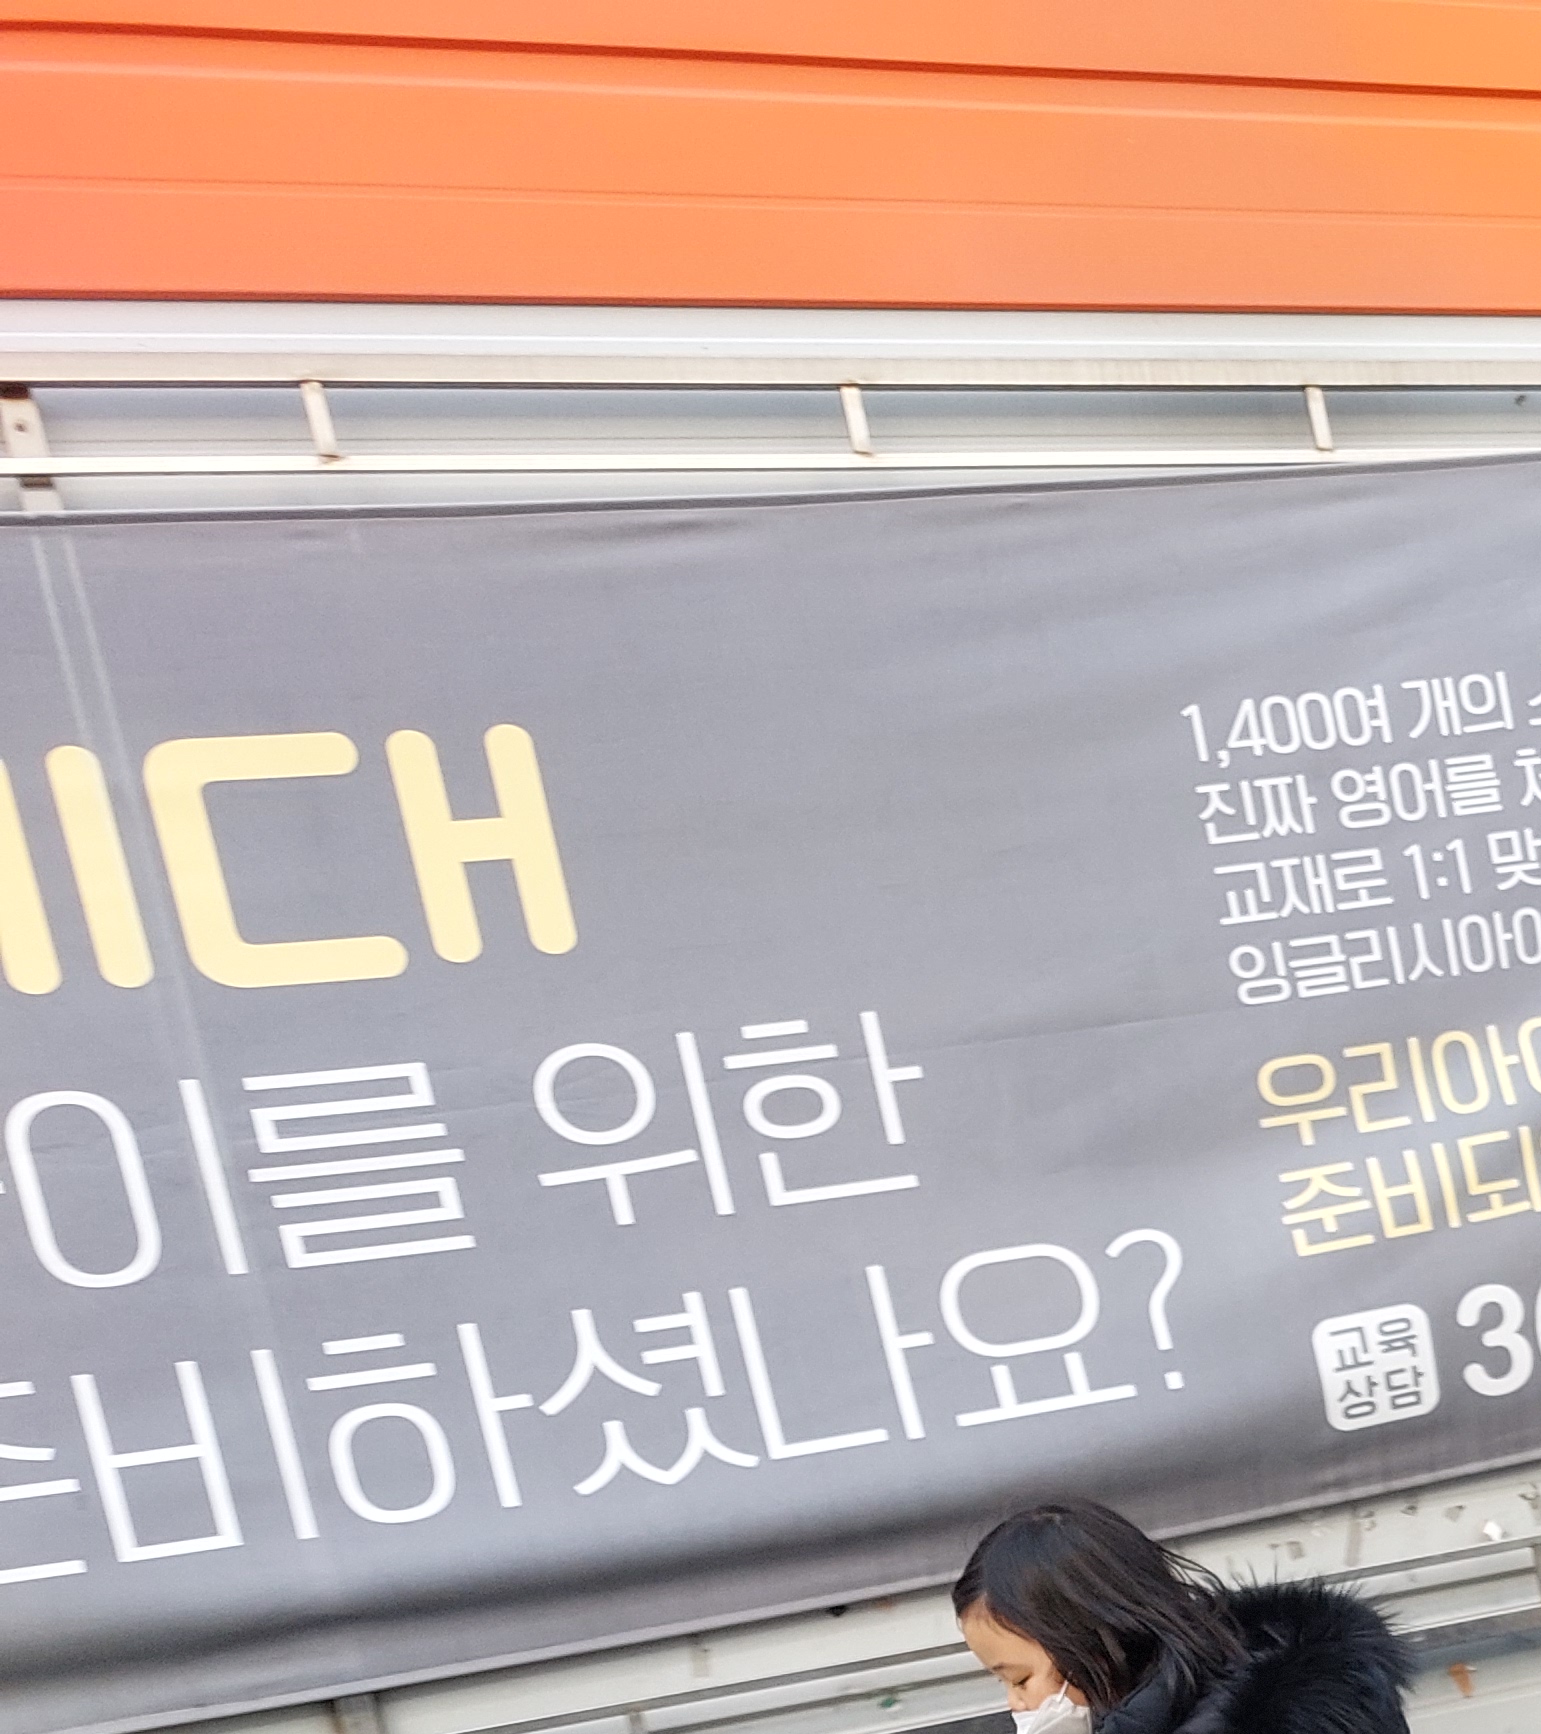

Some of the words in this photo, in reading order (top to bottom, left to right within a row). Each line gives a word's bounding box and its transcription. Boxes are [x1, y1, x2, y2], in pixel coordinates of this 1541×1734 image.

[1180, 684, 1393, 768] 1,400여
[1401, 671, 1514, 738] 개의
[1195, 774, 1318, 845] 진짜
[1330, 753, 1503, 829] 영어를
[1213, 848, 1395, 926] 교재로
[1402, 838, 1473, 900] 1:1
[532, 1010, 924, 1226] 위한
[1328, 1315, 1420, 1373] 교육
[1337, 1366, 1426, 1422] 상담
